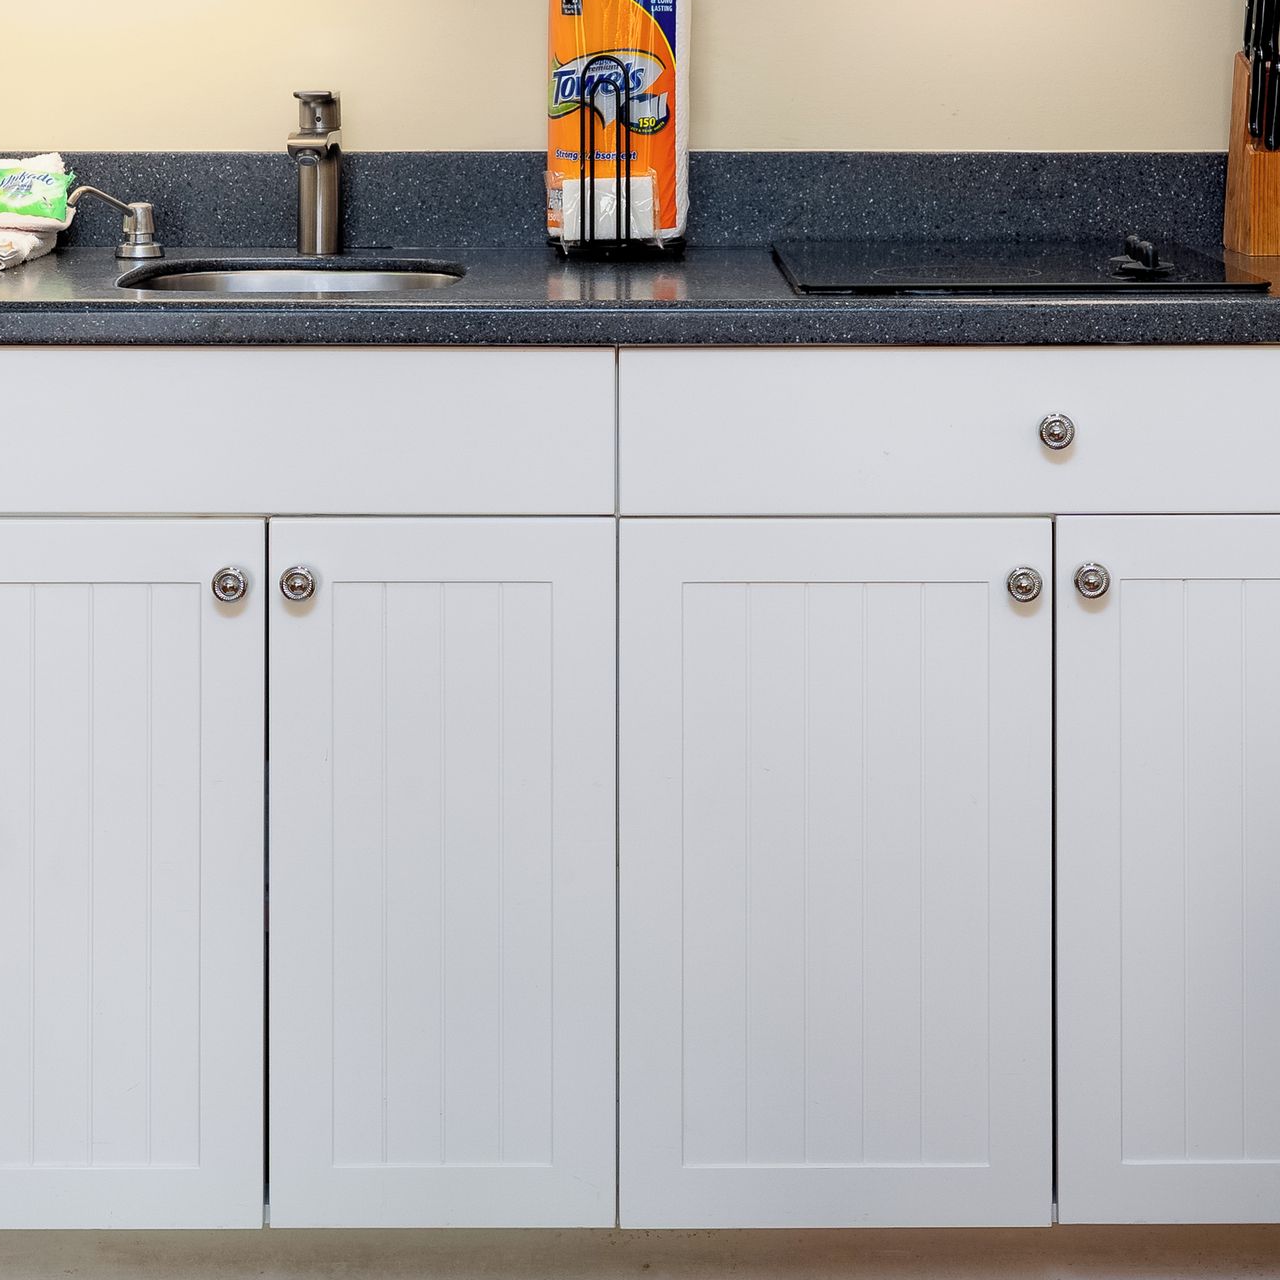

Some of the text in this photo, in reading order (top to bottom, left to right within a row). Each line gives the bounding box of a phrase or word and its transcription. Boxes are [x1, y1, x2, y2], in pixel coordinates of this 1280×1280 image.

[650, 4, 673, 12] LASTING
[638, 117, 656, 128] 150
[556, 150, 578, 161] Strong
